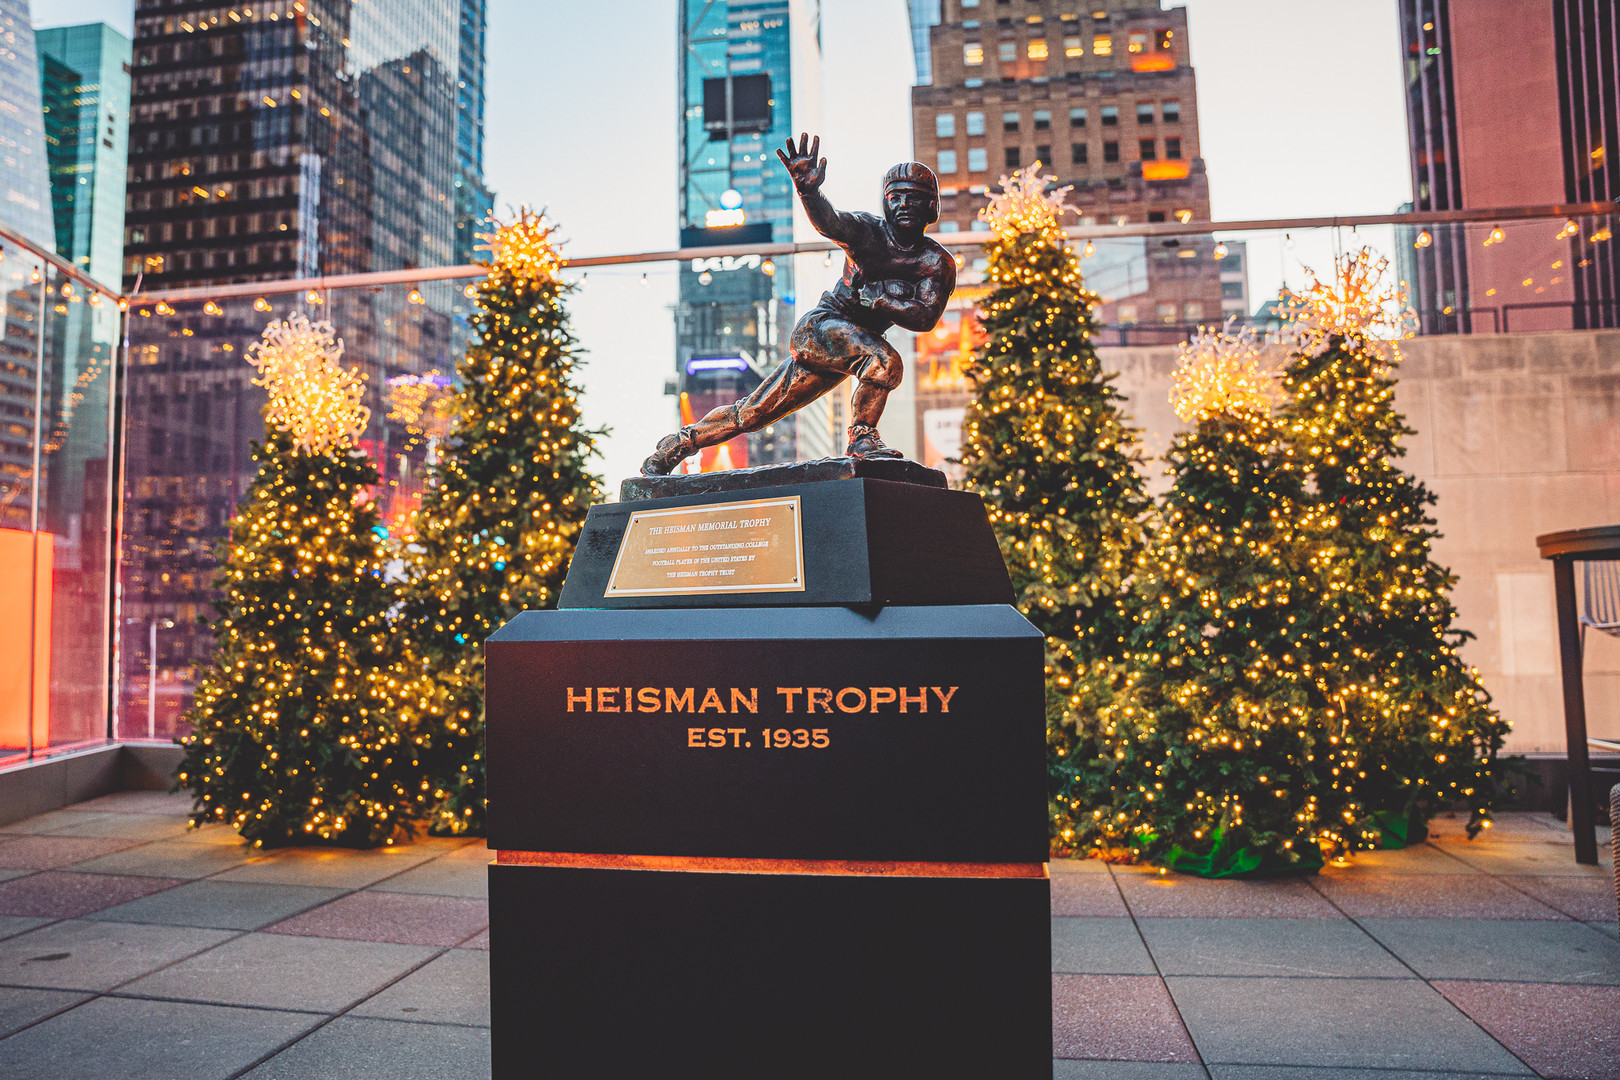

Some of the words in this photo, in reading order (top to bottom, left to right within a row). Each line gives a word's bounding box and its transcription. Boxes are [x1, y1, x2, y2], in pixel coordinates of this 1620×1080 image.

[648, 526, 663, 536] THE
[663, 523, 697, 534] HEISMAN
[697, 520, 738, 532] MEMORIAL
[739, 517, 772, 529] TROPHY
[666, 546, 691, 554] ANNUALLY
[709, 542, 745, 551] OUTSTANDING
[745, 540, 769, 549] COLLEGE
[651, 559, 675, 567] FOOTBALL
[675, 558, 693, 566] PLAYER
[710, 556, 730, 564] UNITED
[730, 555, 748, 563] STATES
[747, 554, 756, 562] BY
[666, 571, 677, 579] THE
[676, 570, 699, 578] HEISMAN
[698, 569, 719, 577] TROPHY
[718, 568, 736, 576] TRUST
[566, 686, 759, 714] HEISMAN
[776, 685, 960, 714] TROPHY
[687, 727, 752, 748] EST.
[761, 727, 831, 749] 1935
